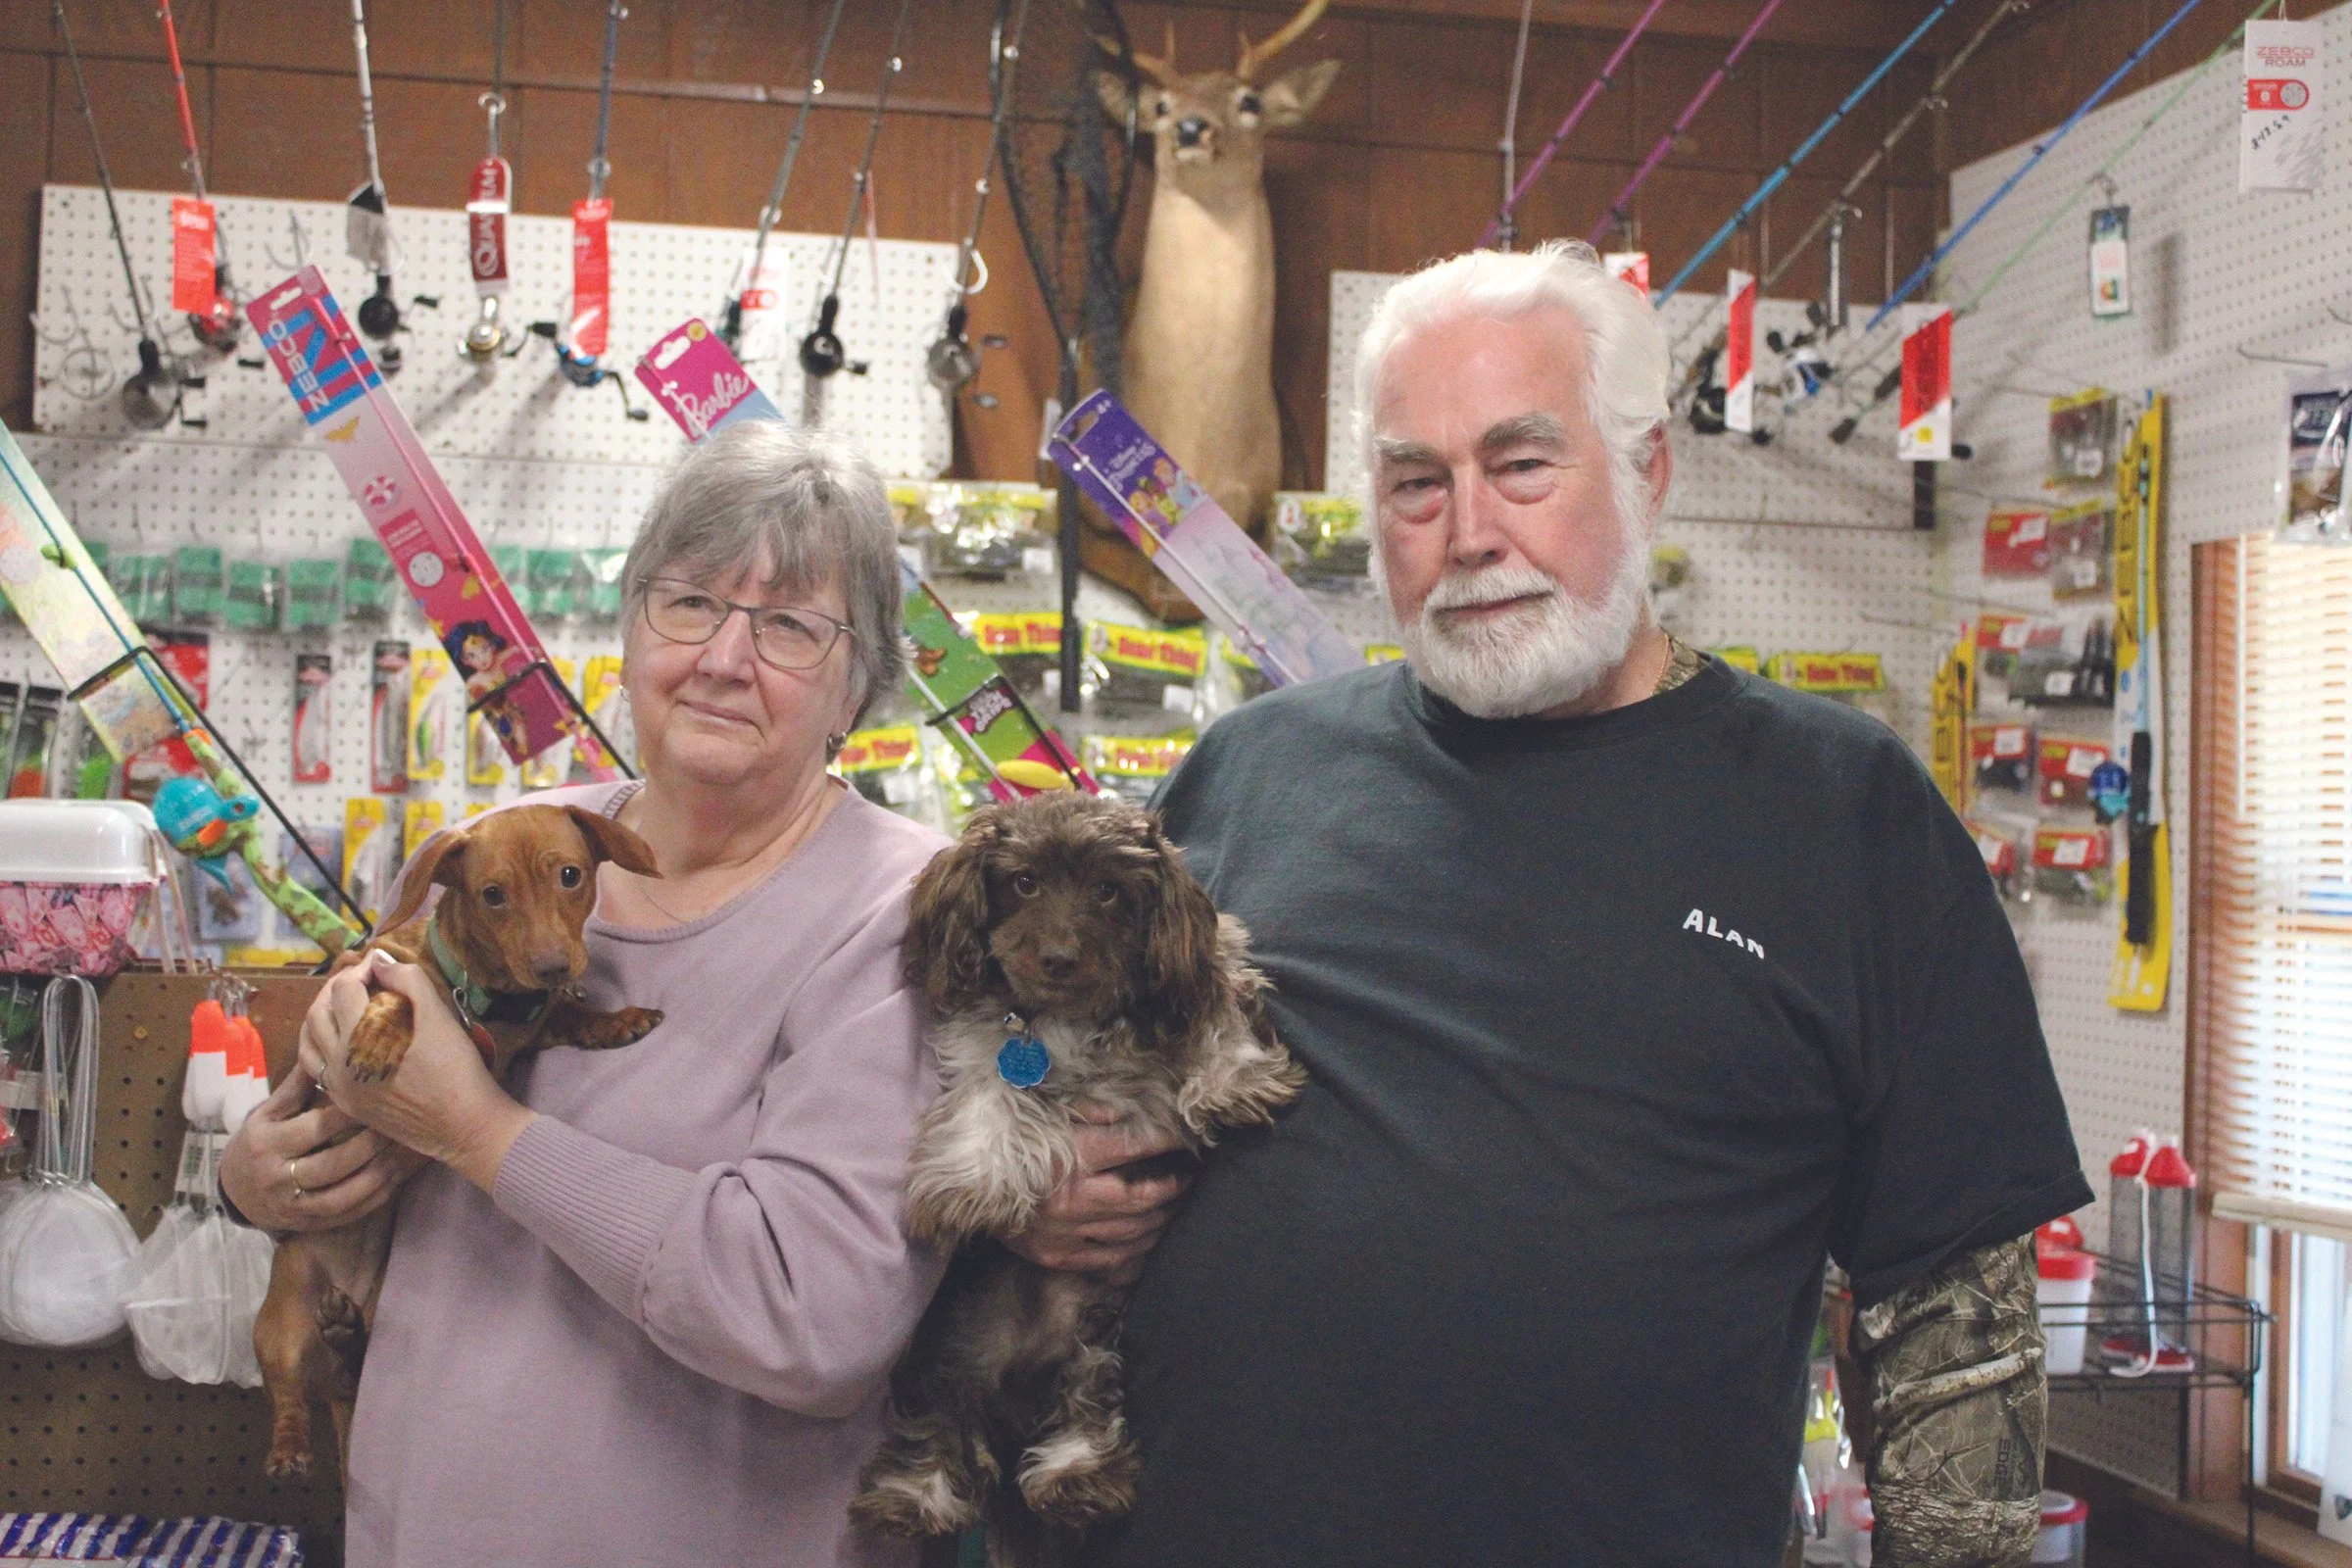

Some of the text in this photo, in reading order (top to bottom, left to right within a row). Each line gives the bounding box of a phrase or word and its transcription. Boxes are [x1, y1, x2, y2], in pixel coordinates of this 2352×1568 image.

[2257, 46, 2315, 58] ZEBCO
[2264, 58, 2306, 68] ROAM
[473, 165, 500, 277] QUANUM
[268, 318, 330, 414] ZEBCO
[674, 371, 751, 438] Barbie
[1682, 907, 1766, 960] ALAN
